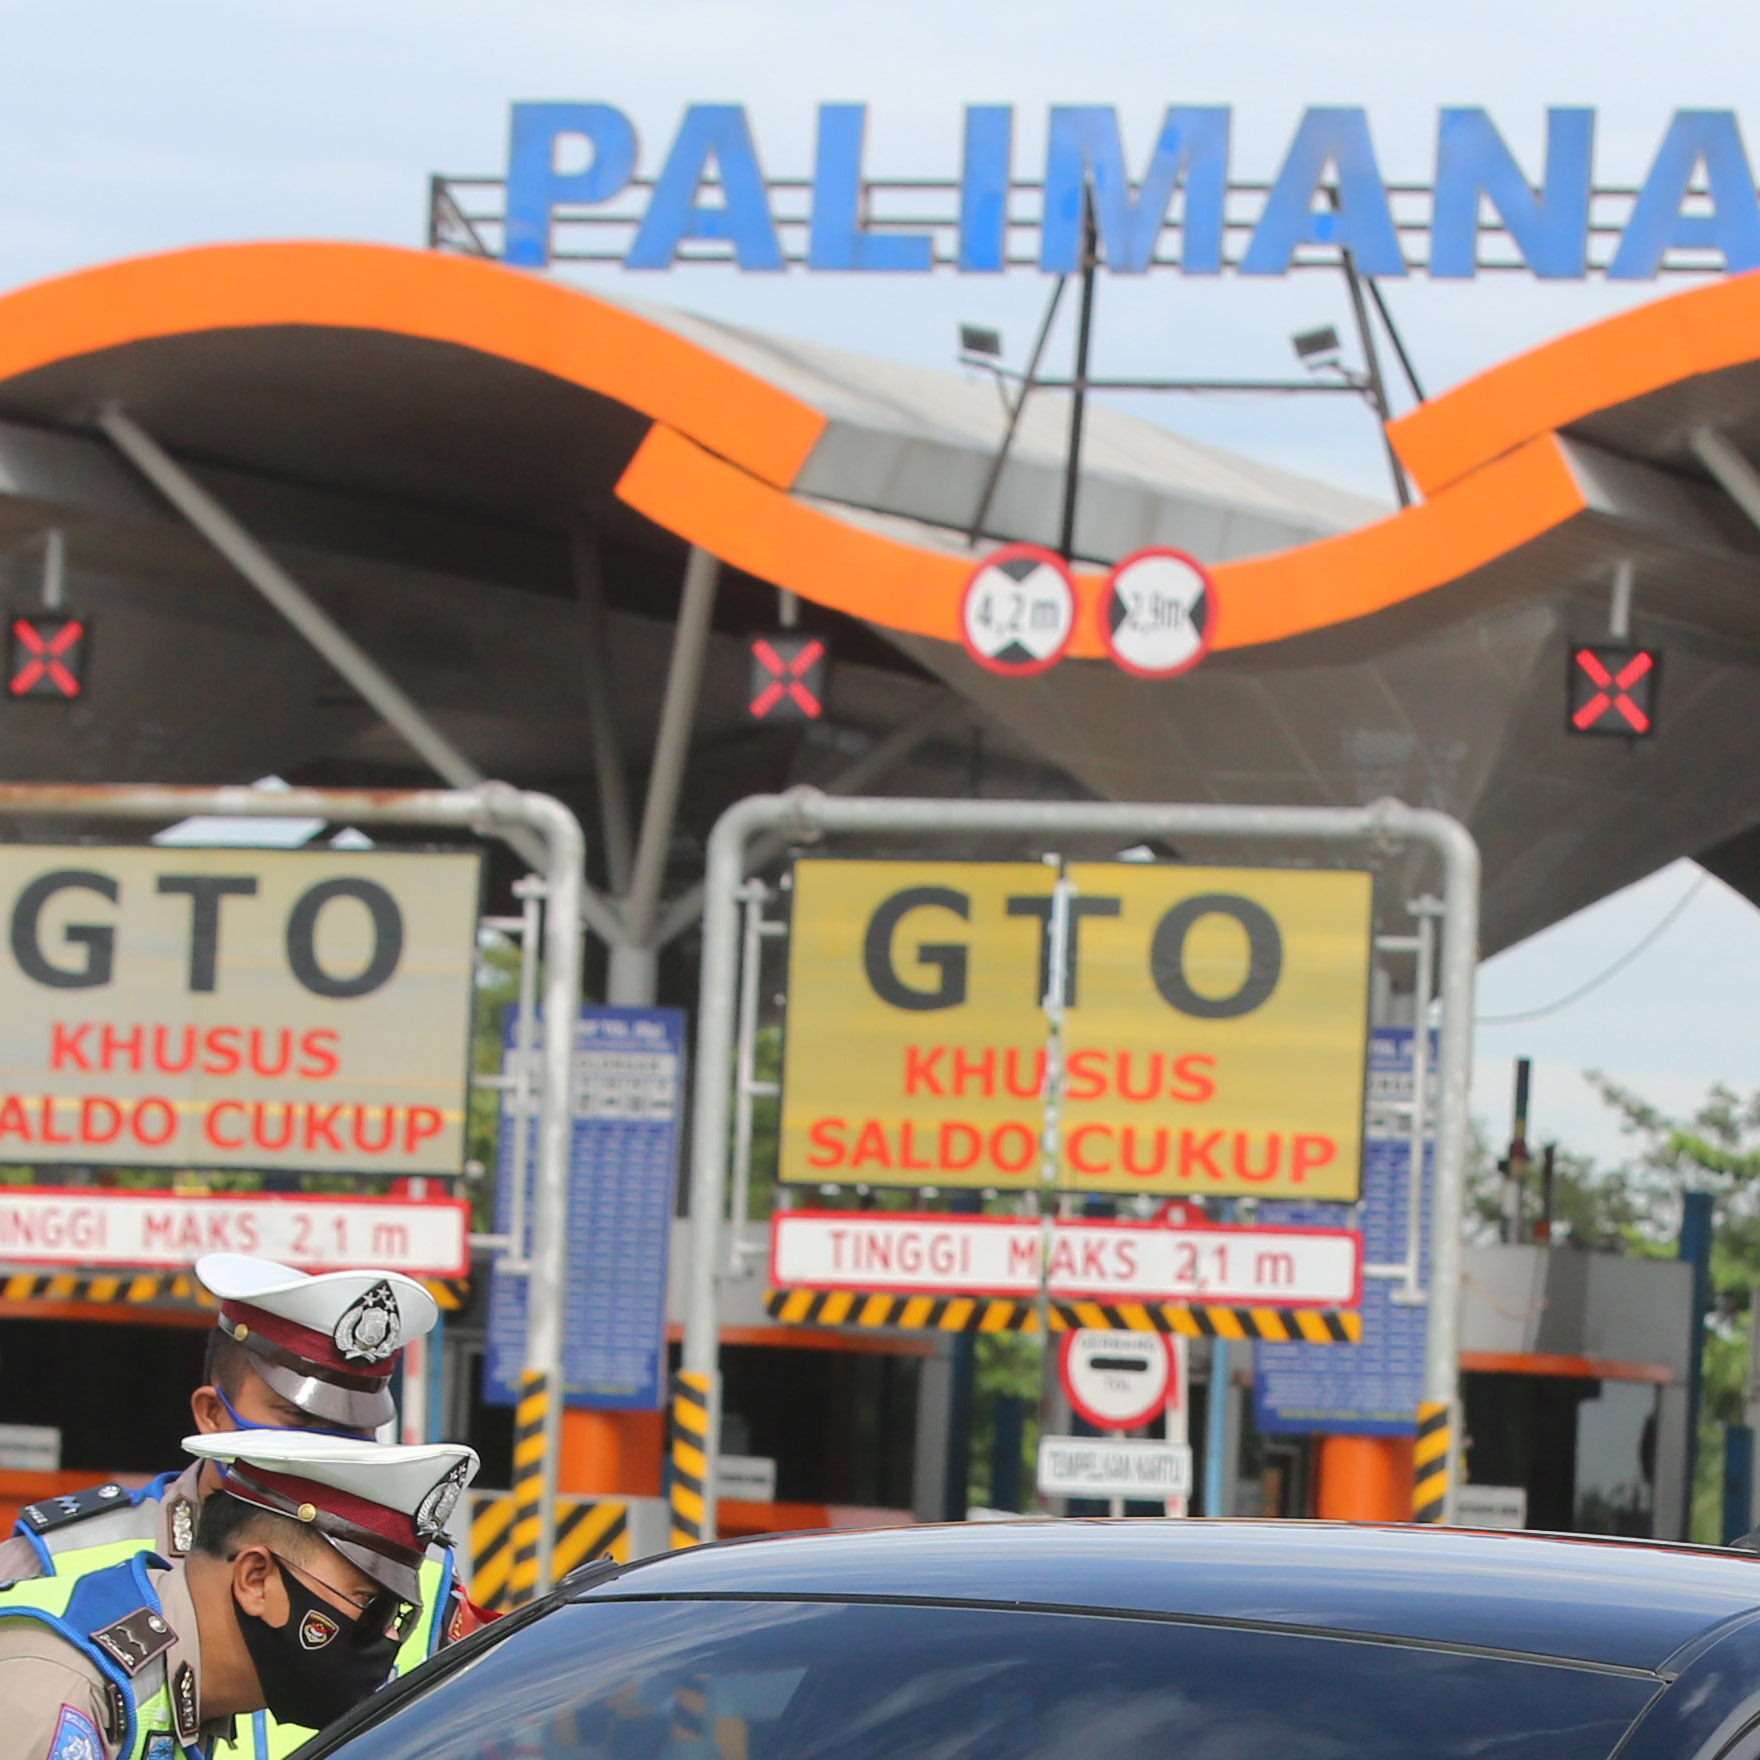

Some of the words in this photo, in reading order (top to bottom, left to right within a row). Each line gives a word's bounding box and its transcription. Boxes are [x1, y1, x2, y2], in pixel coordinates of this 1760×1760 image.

[7, 868, 406, 1000] GTO
[861, 885, 1285, 1019] GTO
[49, 1020, 341, 1081] KHUSUS
[904, 1045, 1218, 1104] KHUSUS
[202, 1103, 445, 1157] CUKUP
[806, 1117, 1040, 1175] SALDO
[1065, 1123, 1337, 1187] CUKUP
[145, 1208, 258, 1253] MAKS
[372, 1221, 409, 1256] m
[827, 1229, 970, 1275] TINGGI
[1007, 1234, 1138, 1281] MAKS
[1175, 1241, 1229, 1292] 2,1
[1255, 1251, 1295, 1286] m
